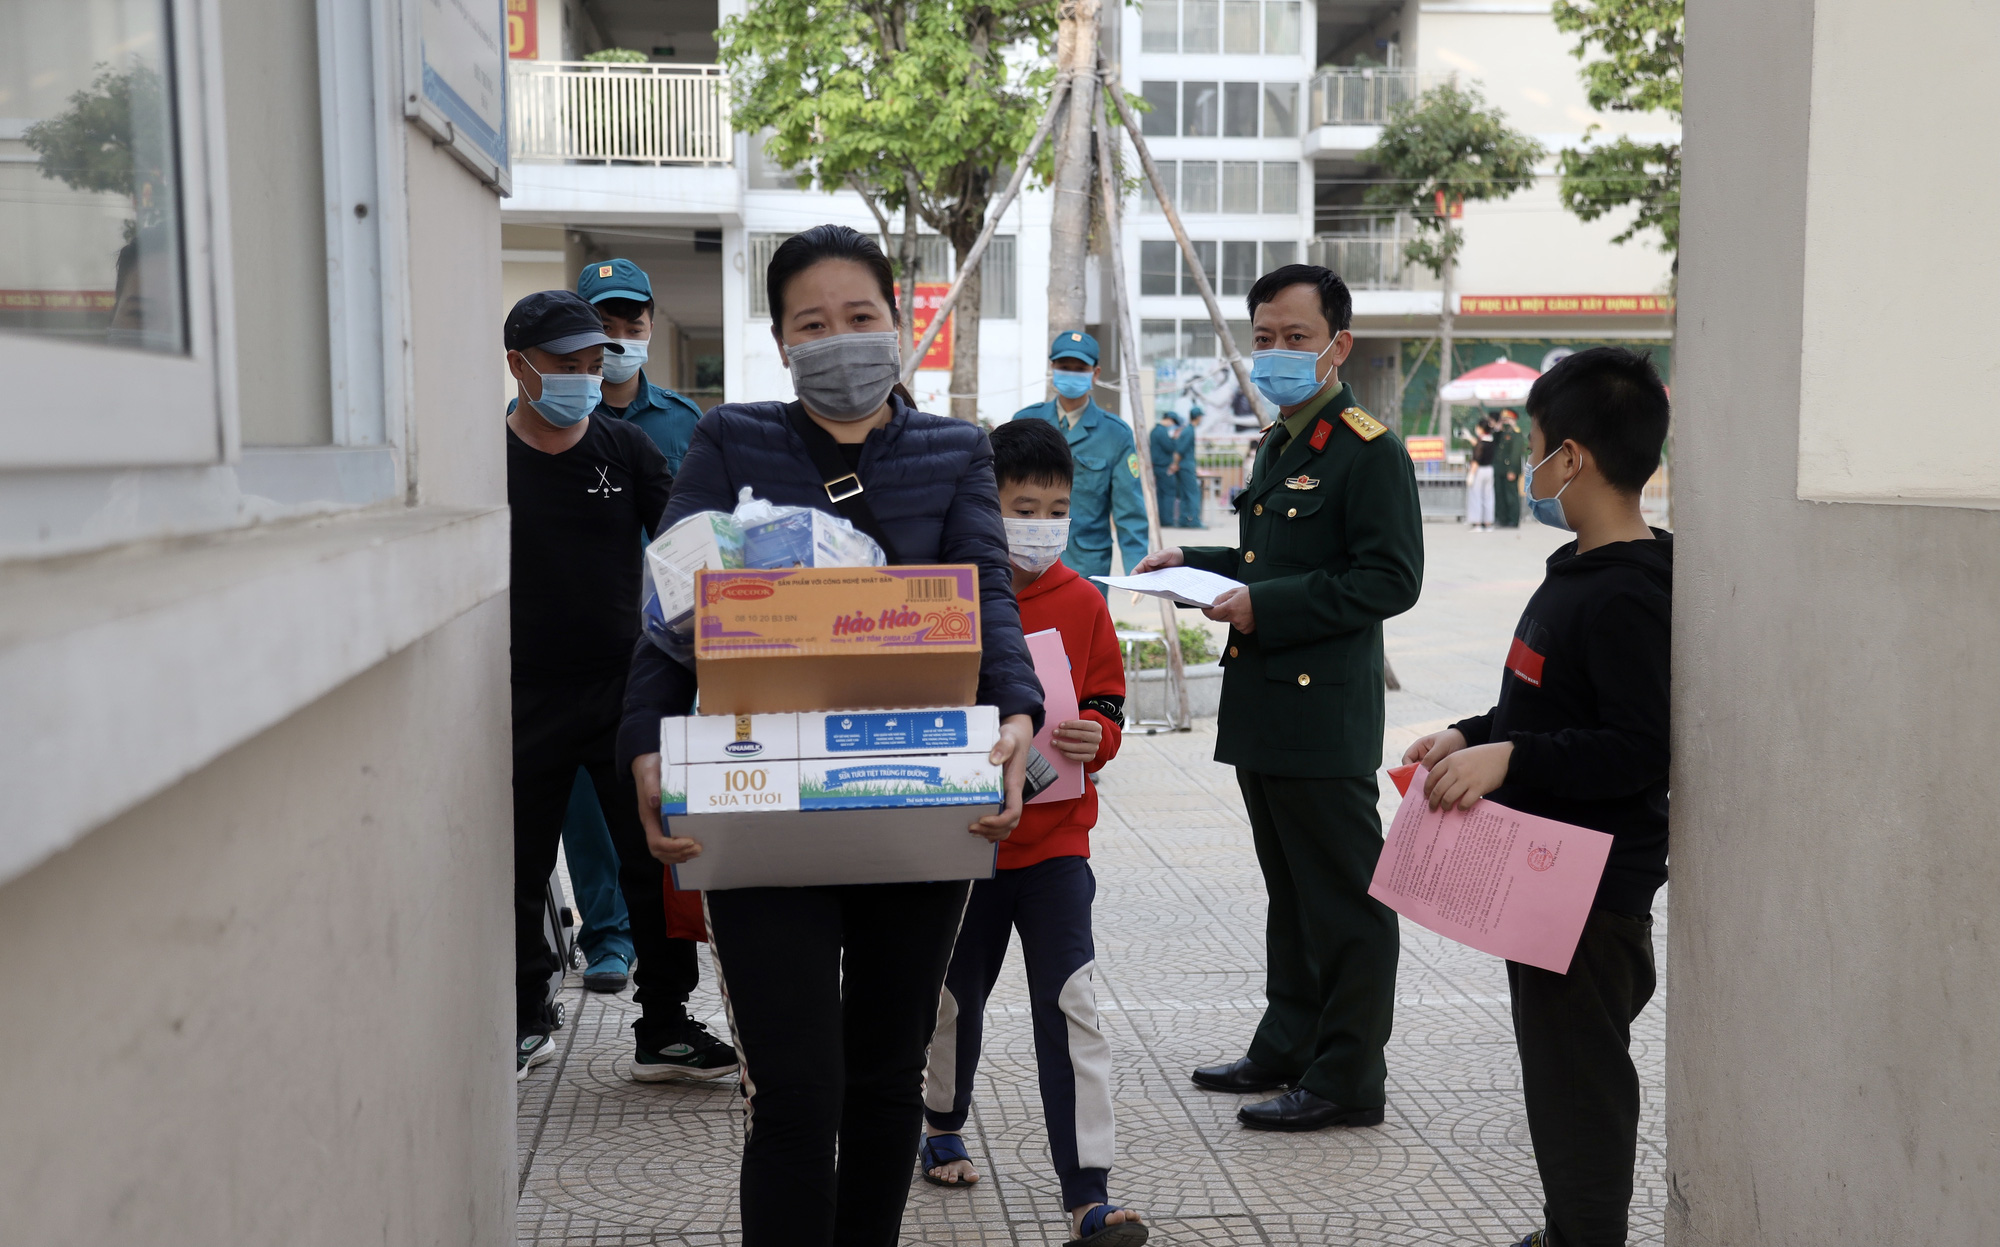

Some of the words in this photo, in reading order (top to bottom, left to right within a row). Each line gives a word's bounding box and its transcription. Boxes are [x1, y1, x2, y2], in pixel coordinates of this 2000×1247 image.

[832, 610, 876, 636] Hảo
[879, 604, 922, 630] Hảo
[923, 611, 971, 641] 20
[726, 744, 761, 752] VINAMILK
[708, 793, 739, 807] SỮA
[742, 792, 782, 805] TƯƠI
